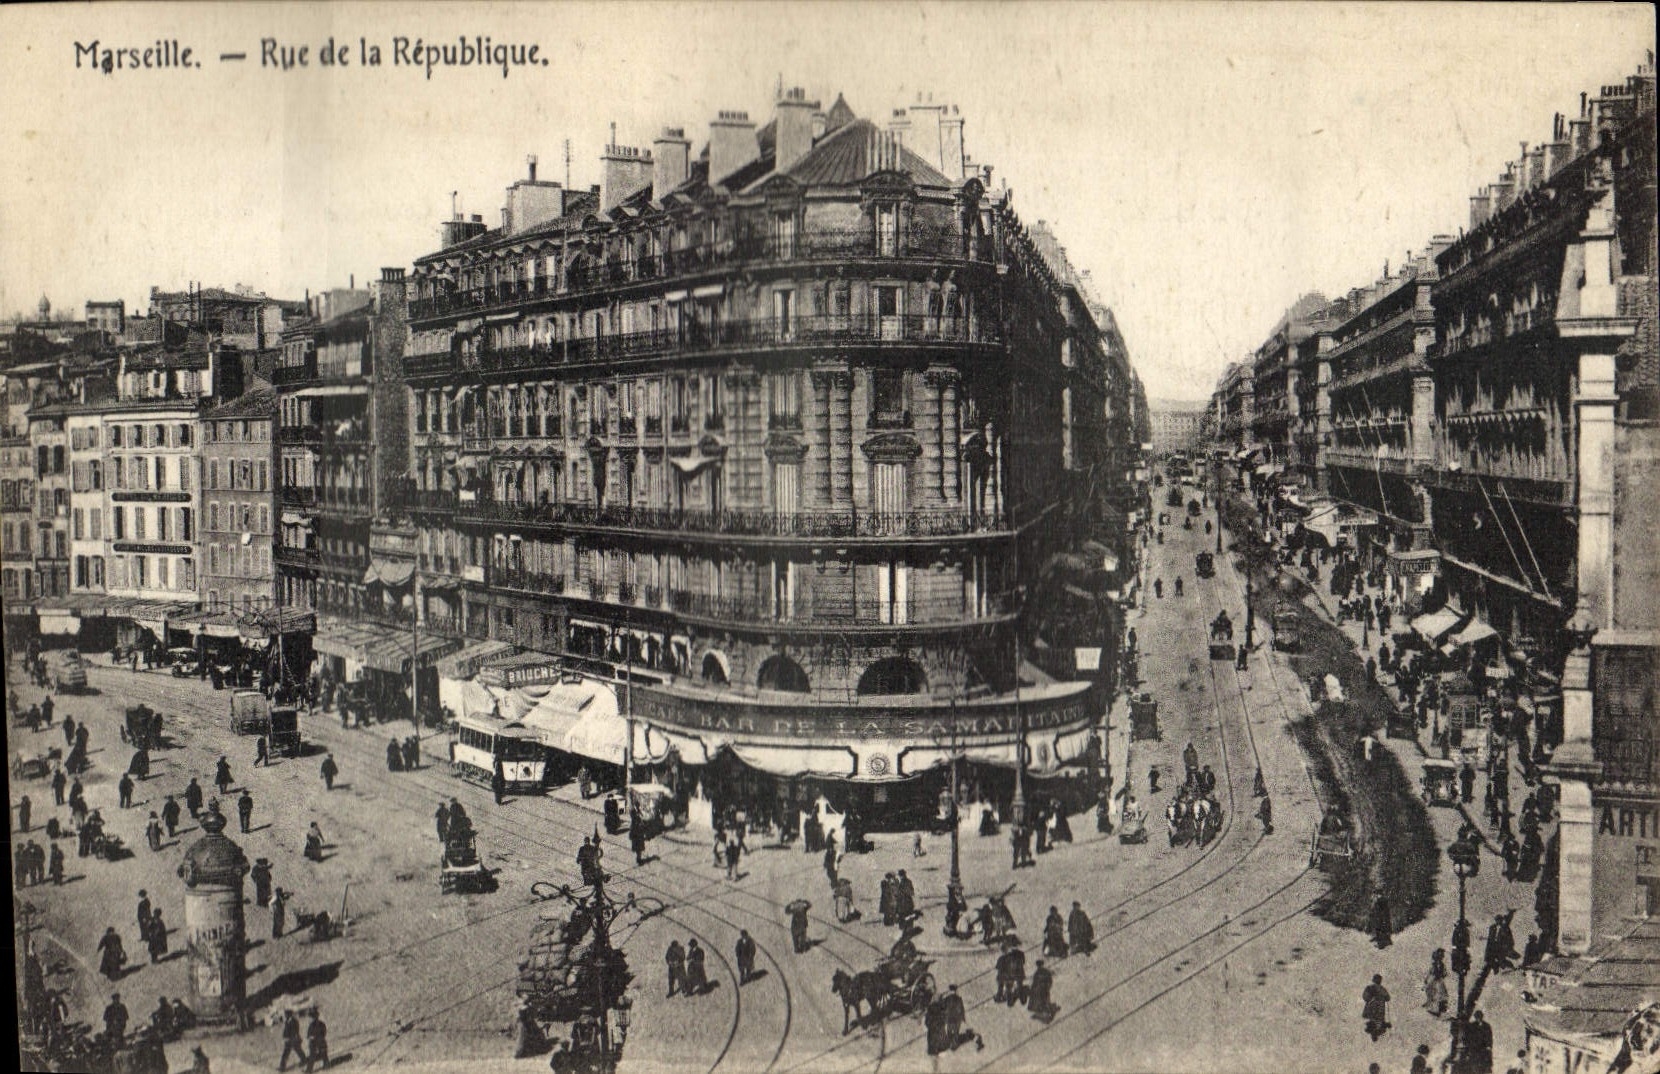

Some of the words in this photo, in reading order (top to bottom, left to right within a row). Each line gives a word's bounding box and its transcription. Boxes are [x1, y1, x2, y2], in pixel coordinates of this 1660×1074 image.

[700, 714, 754, 732] BAR
[774, 720, 815, 734] DE
[836, 721, 883, 735] LA
